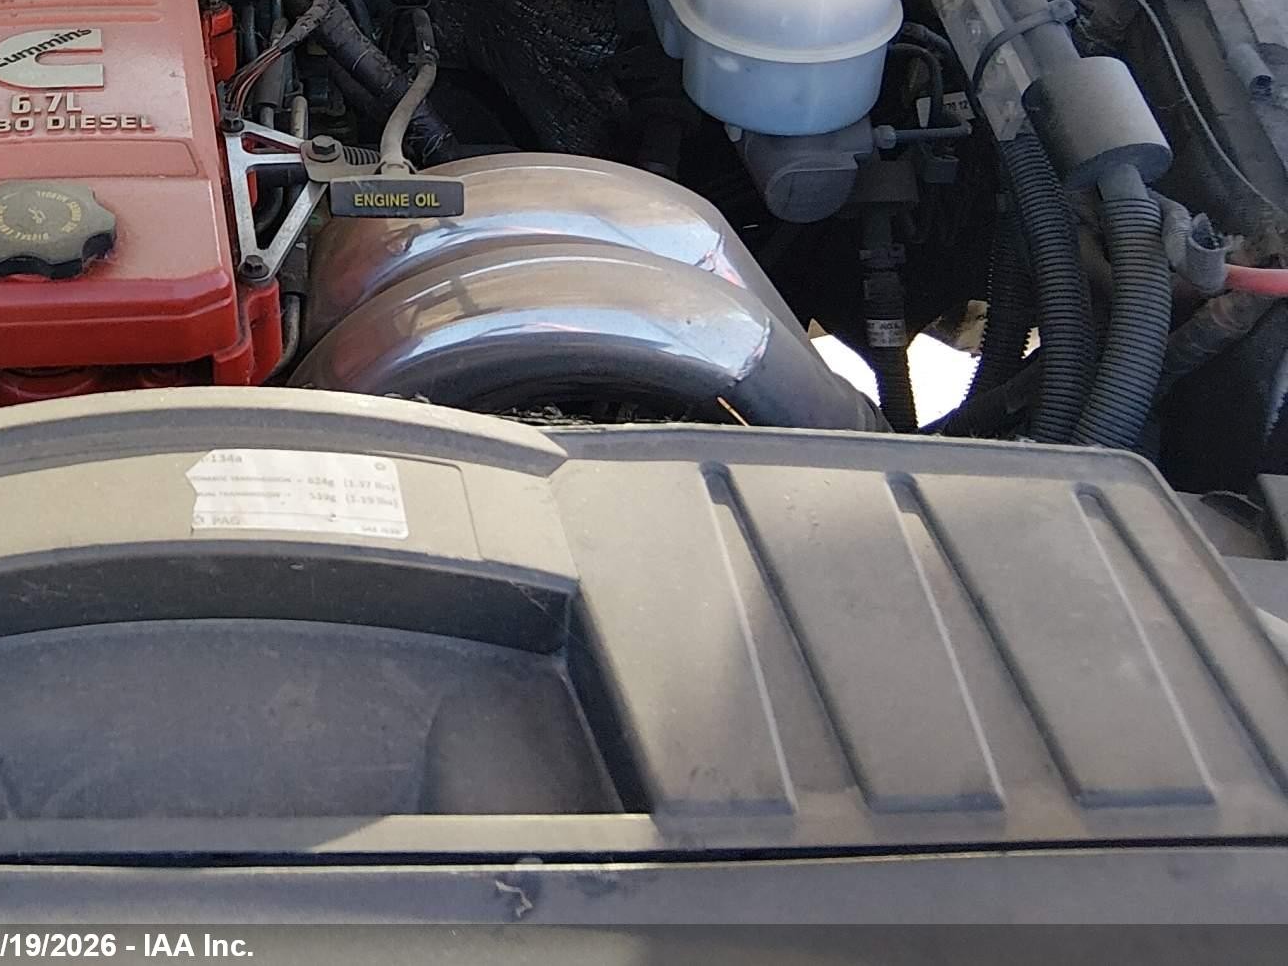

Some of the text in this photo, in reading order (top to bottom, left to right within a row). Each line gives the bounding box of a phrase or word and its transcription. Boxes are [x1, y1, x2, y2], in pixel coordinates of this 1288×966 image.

[11, 92, 83, 115] 6.7L
[46, 114, 156, 131] DIESEL
[354, 193, 441, 207] ENGINE OIL
